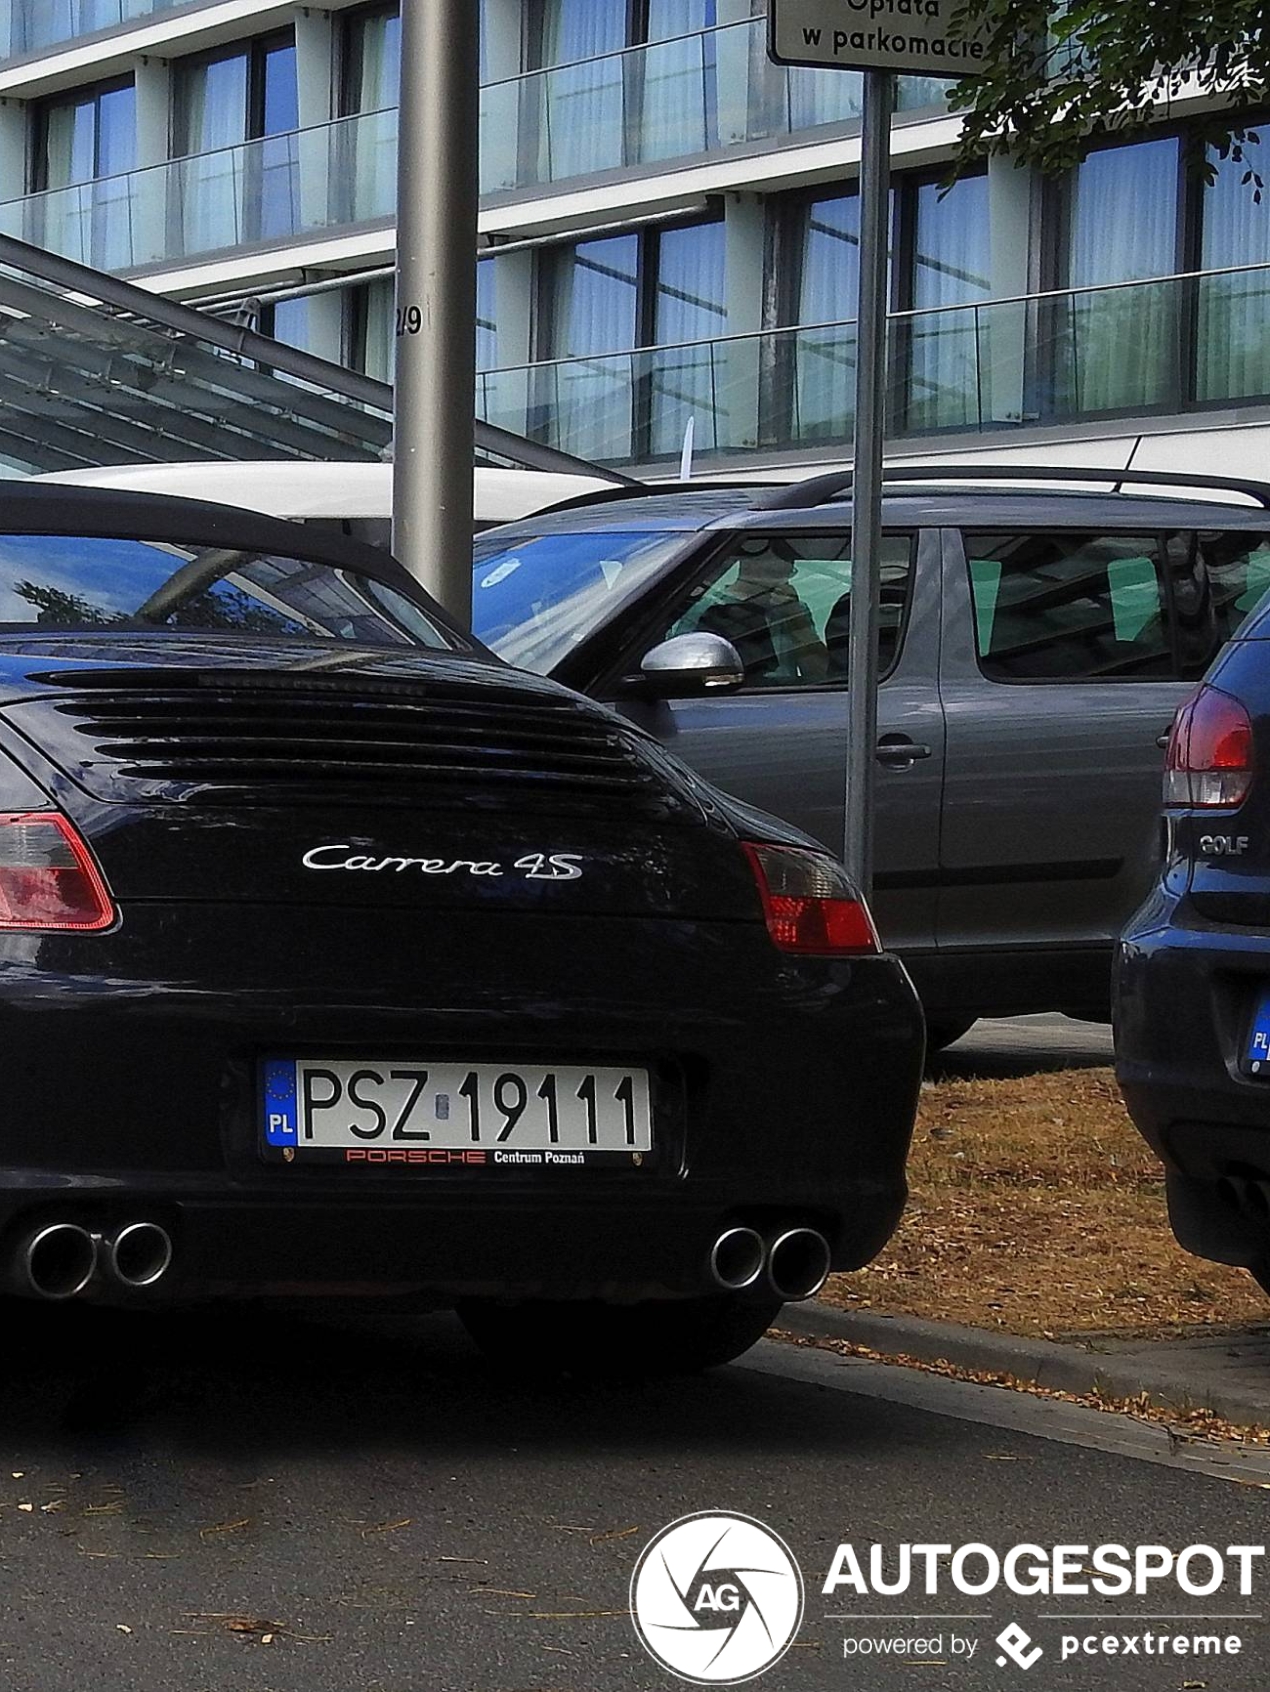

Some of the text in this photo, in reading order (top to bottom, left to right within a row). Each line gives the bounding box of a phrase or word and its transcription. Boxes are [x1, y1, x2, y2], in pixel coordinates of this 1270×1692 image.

[803, 27, 984, 59] w parkomacie
[1200, 835, 1249, 855] GOLF
[302, 844, 583, 880] Carrera 4S
[1253, 1032, 1268, 1049] PL
[302, 1068, 636, 1145] PSZ 19111
[269, 1114, 294, 1134] PL
[345, 1149, 585, 1165] PORSCHE Centrum Poznań
